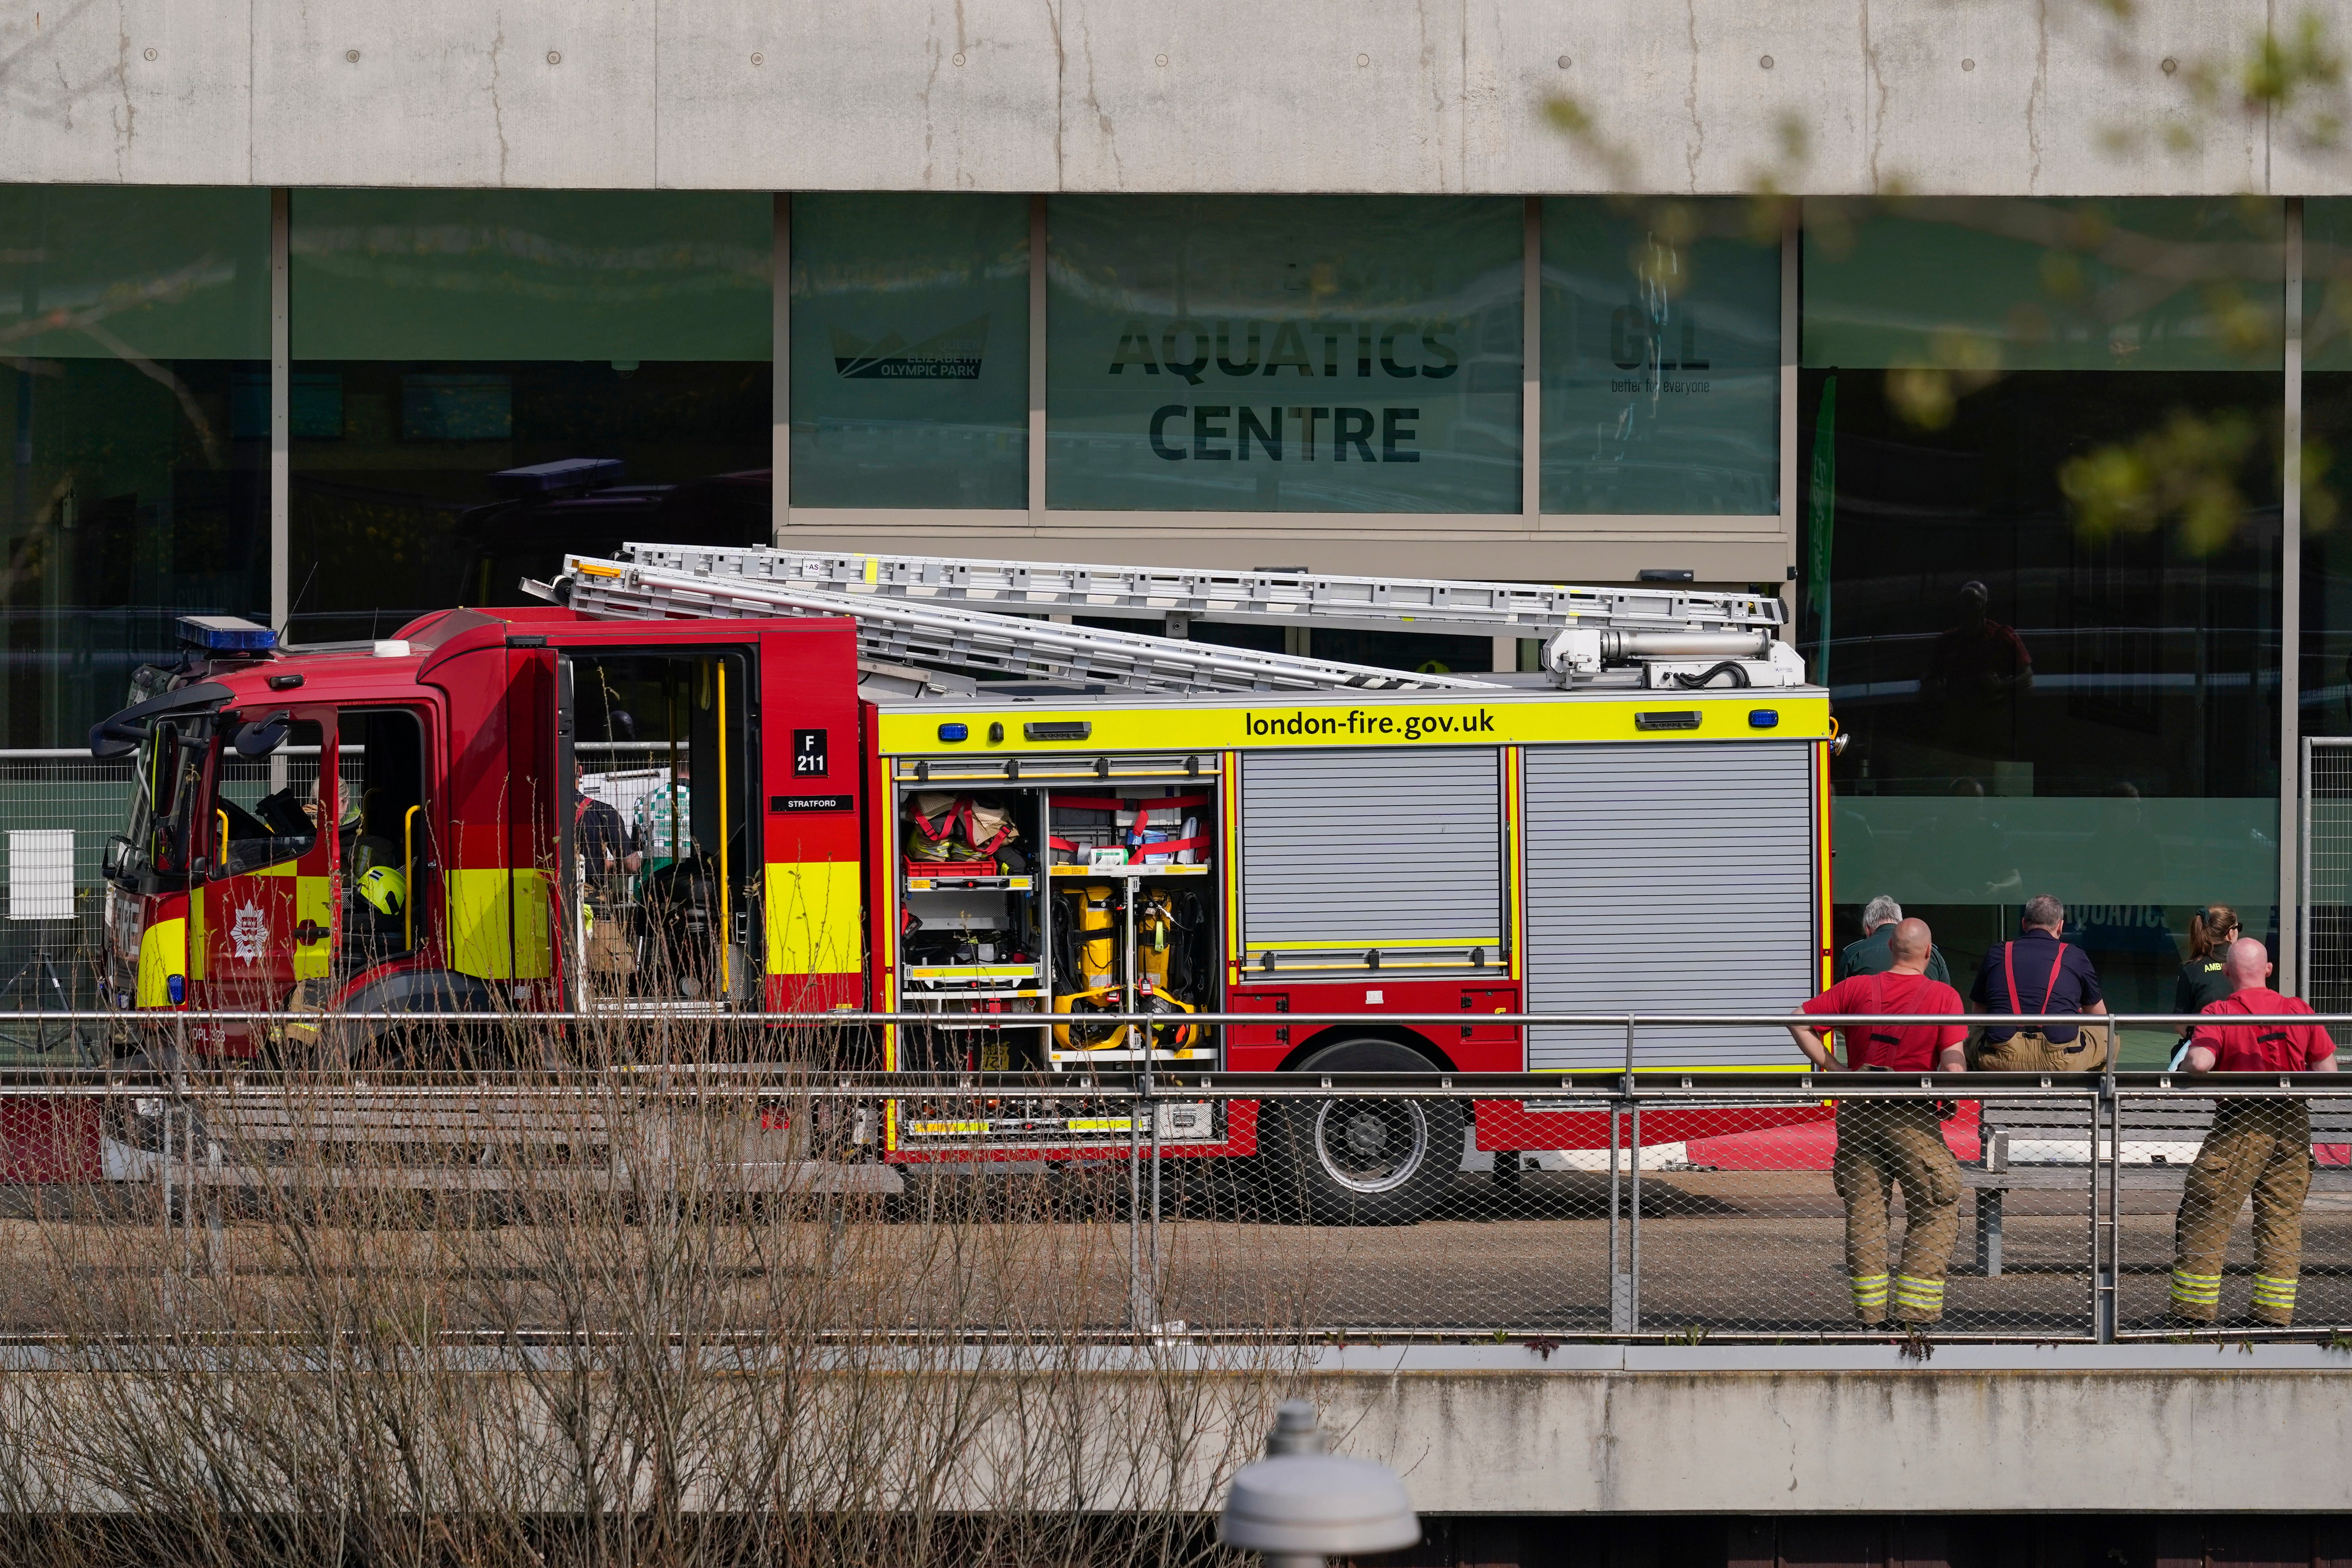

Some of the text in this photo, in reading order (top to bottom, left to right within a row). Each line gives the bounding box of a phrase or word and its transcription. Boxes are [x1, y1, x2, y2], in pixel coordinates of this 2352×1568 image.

[937, 339, 981, 352] QUEEN
[1611, 304, 1709, 370] GLL
[907, 352, 979, 364] ELIZABETH
[1108, 320, 1459, 386] AQUATICS
[881, 364, 975, 376] OLYMPIC PARK
[1612, 378, 1641, 393] better
[1663, 381, 1709, 396] everyone
[1149, 405, 1421, 463] CENTRE
[1246, 708, 1495, 740] london-fire.gov.uk
[805, 736, 814, 751] F
[798, 755, 823, 771] 211
[115, 898, 139, 955] FIRE
